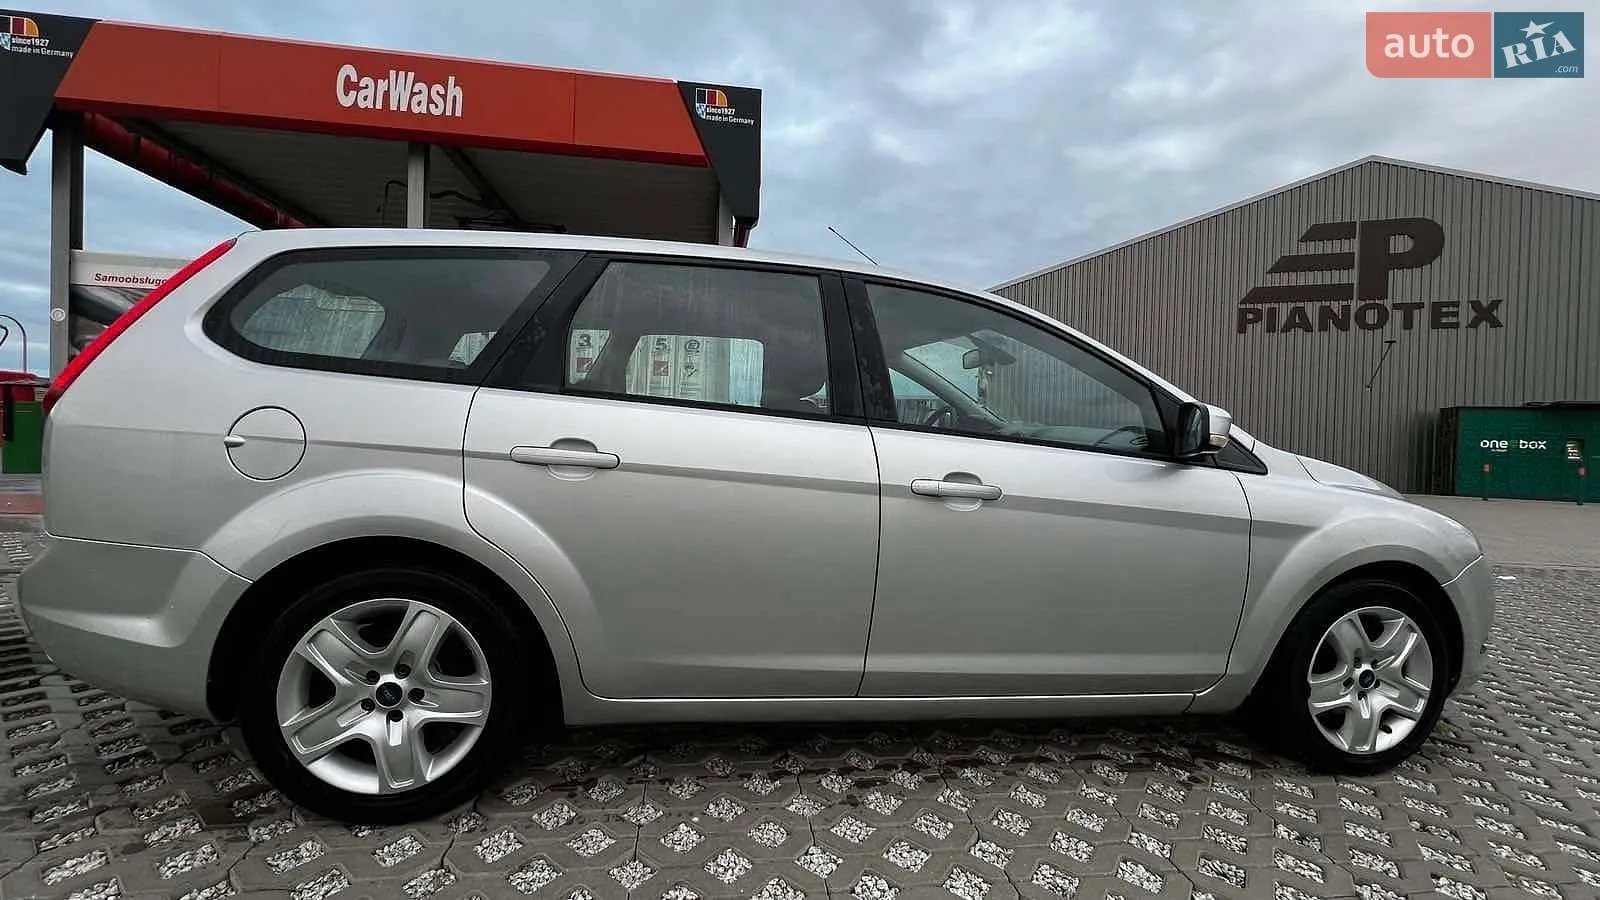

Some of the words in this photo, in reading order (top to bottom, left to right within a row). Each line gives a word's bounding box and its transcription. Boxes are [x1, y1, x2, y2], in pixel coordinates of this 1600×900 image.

[41, 48, 73, 59] Germany
[336, 64, 463, 117] CarWash
[729, 116, 754, 125] Germany
[1237, 299, 1504, 334] PIANOTEX
[578, 334, 591, 347] 3
